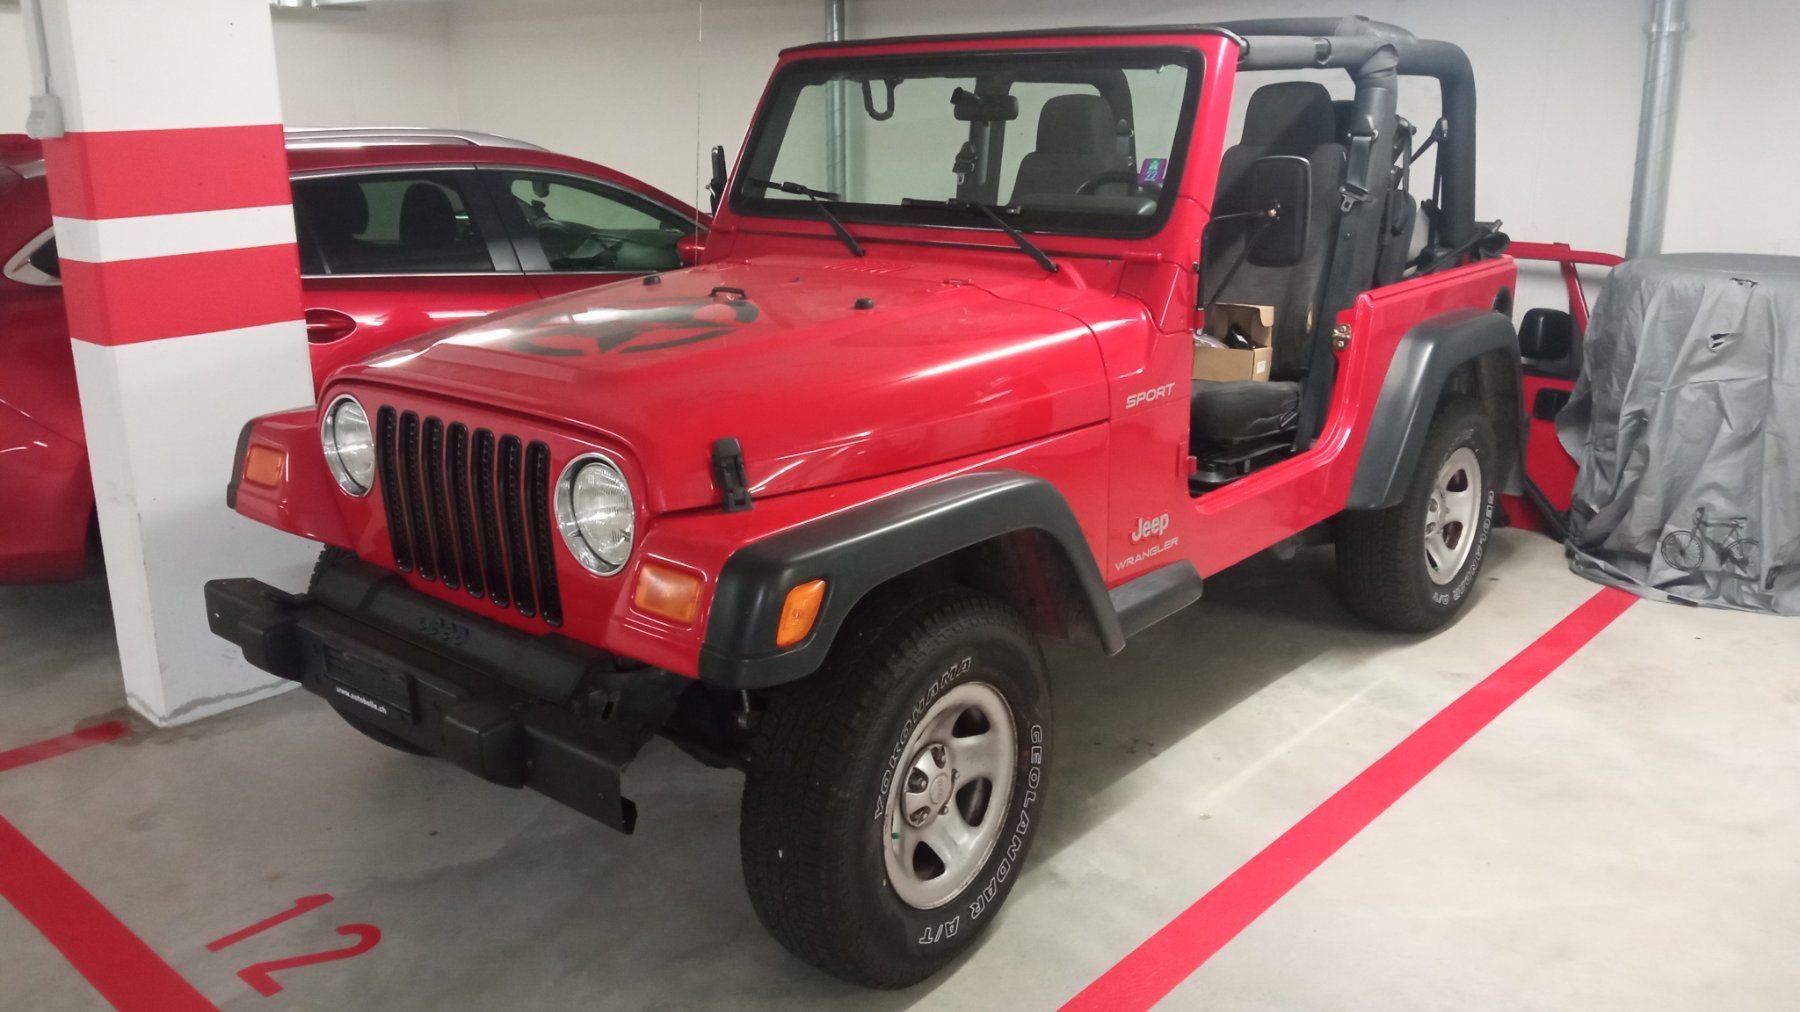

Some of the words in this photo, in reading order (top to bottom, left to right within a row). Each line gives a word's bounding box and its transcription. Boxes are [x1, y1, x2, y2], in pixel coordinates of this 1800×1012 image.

[1125, 381, 1176, 409] SPORT
[1131, 513, 1170, 542] Jeep
[1114, 537, 1179, 571] WRANGLER
[874, 656, 972, 821] YOKOHAMA
[969, 724, 1043, 920] GEOLANDAR
[205, 893, 382, 998] 12
[918, 915, 960, 945] A/T
